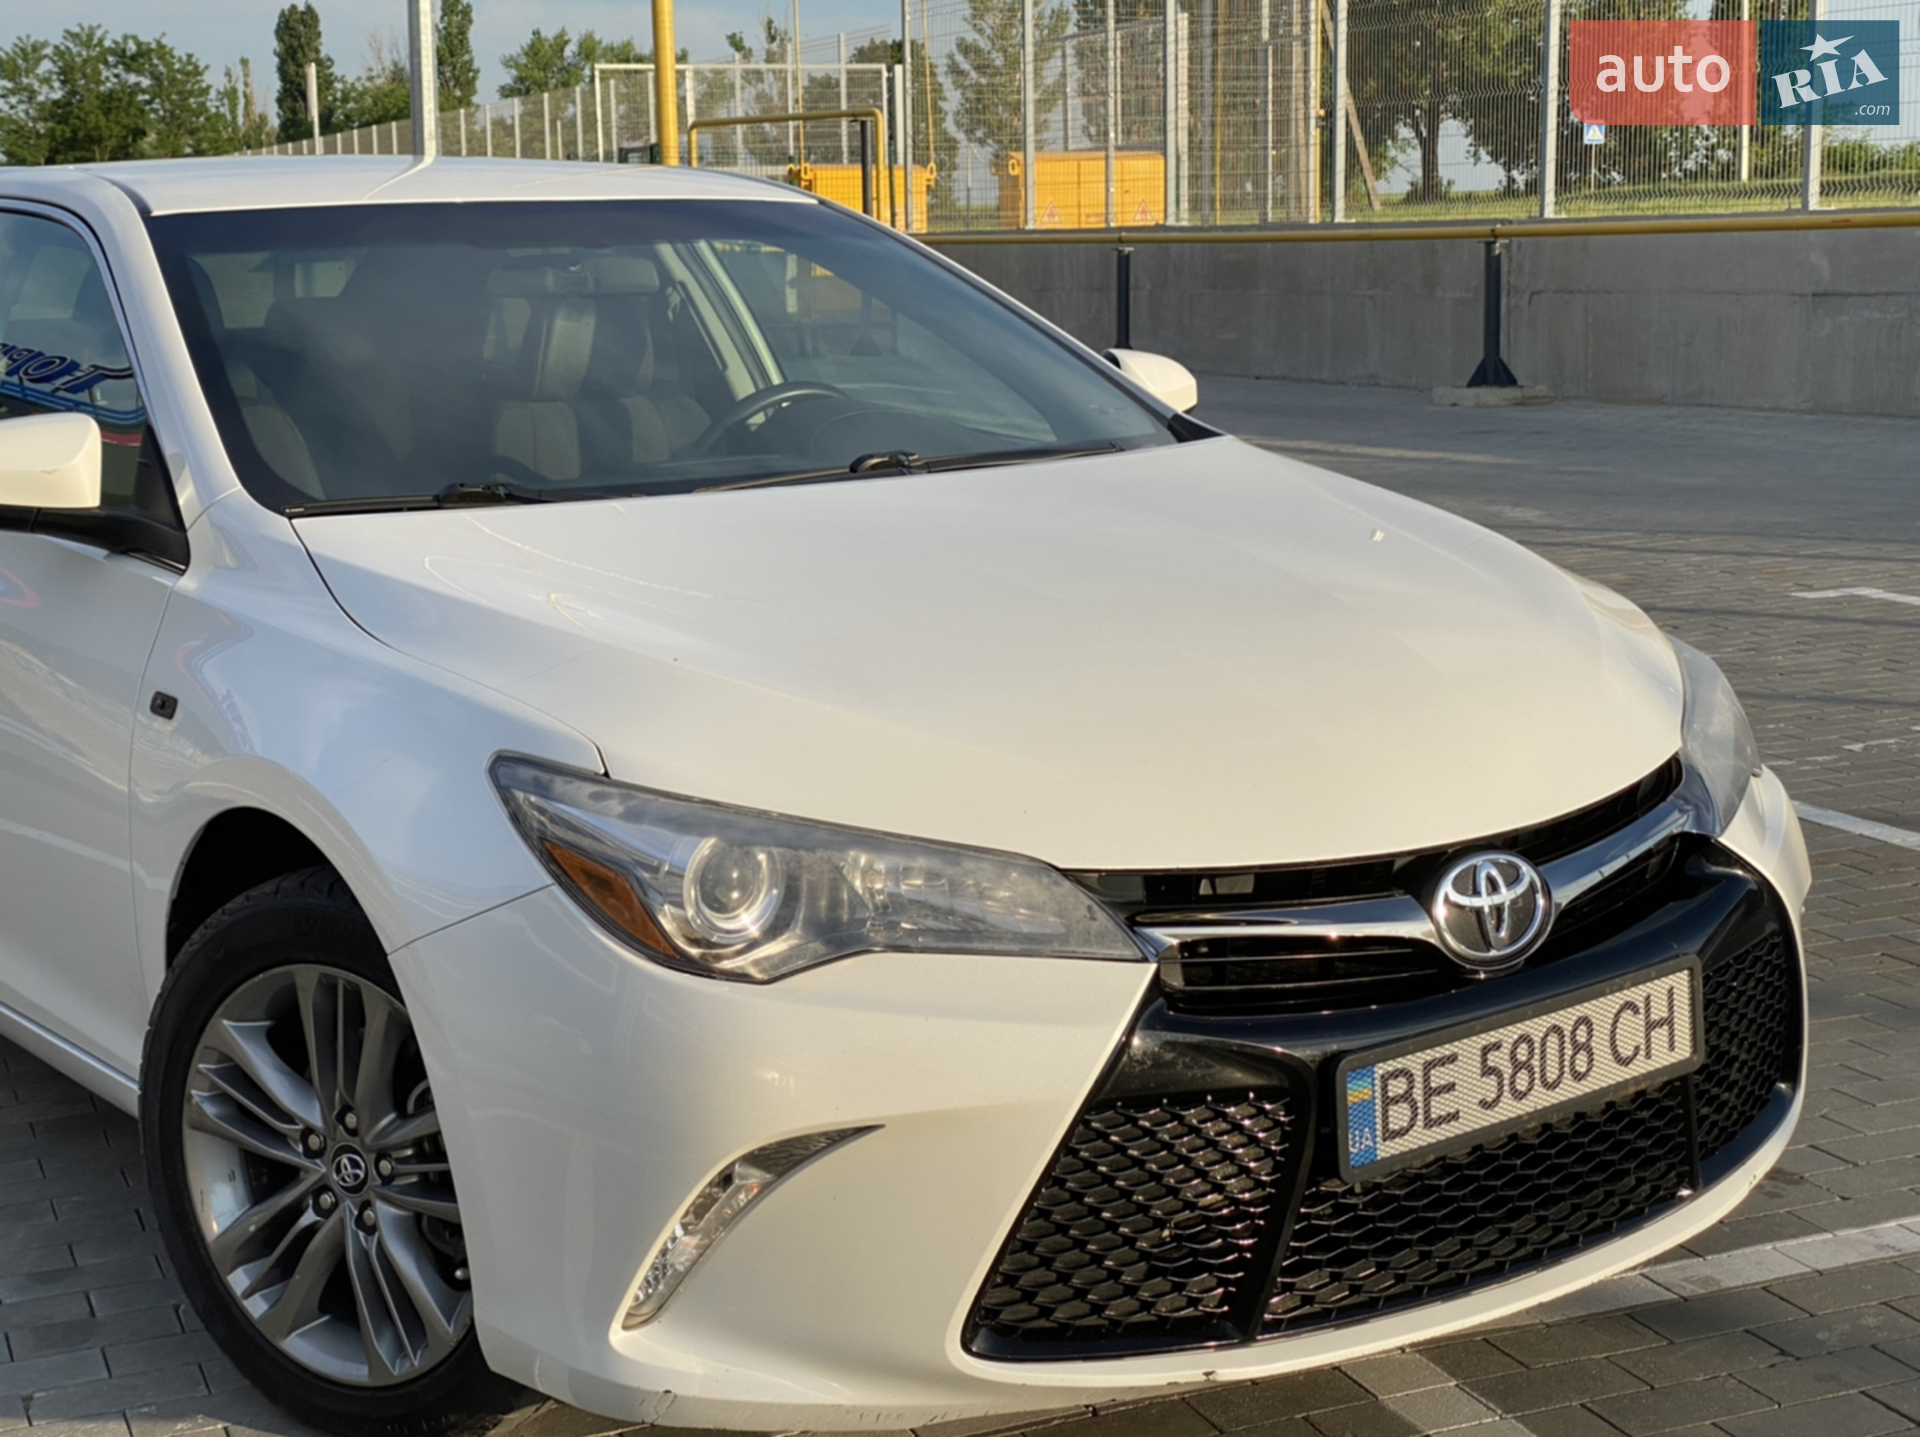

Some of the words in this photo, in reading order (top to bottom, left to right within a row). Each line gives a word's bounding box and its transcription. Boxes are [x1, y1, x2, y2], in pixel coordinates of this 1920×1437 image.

[1380, 1052, 1461, 1142] BE
[1478, 1015, 1595, 1111] 5808
[1609, 986, 1676, 1067] CH
[1348, 1127, 1374, 1153] UA
